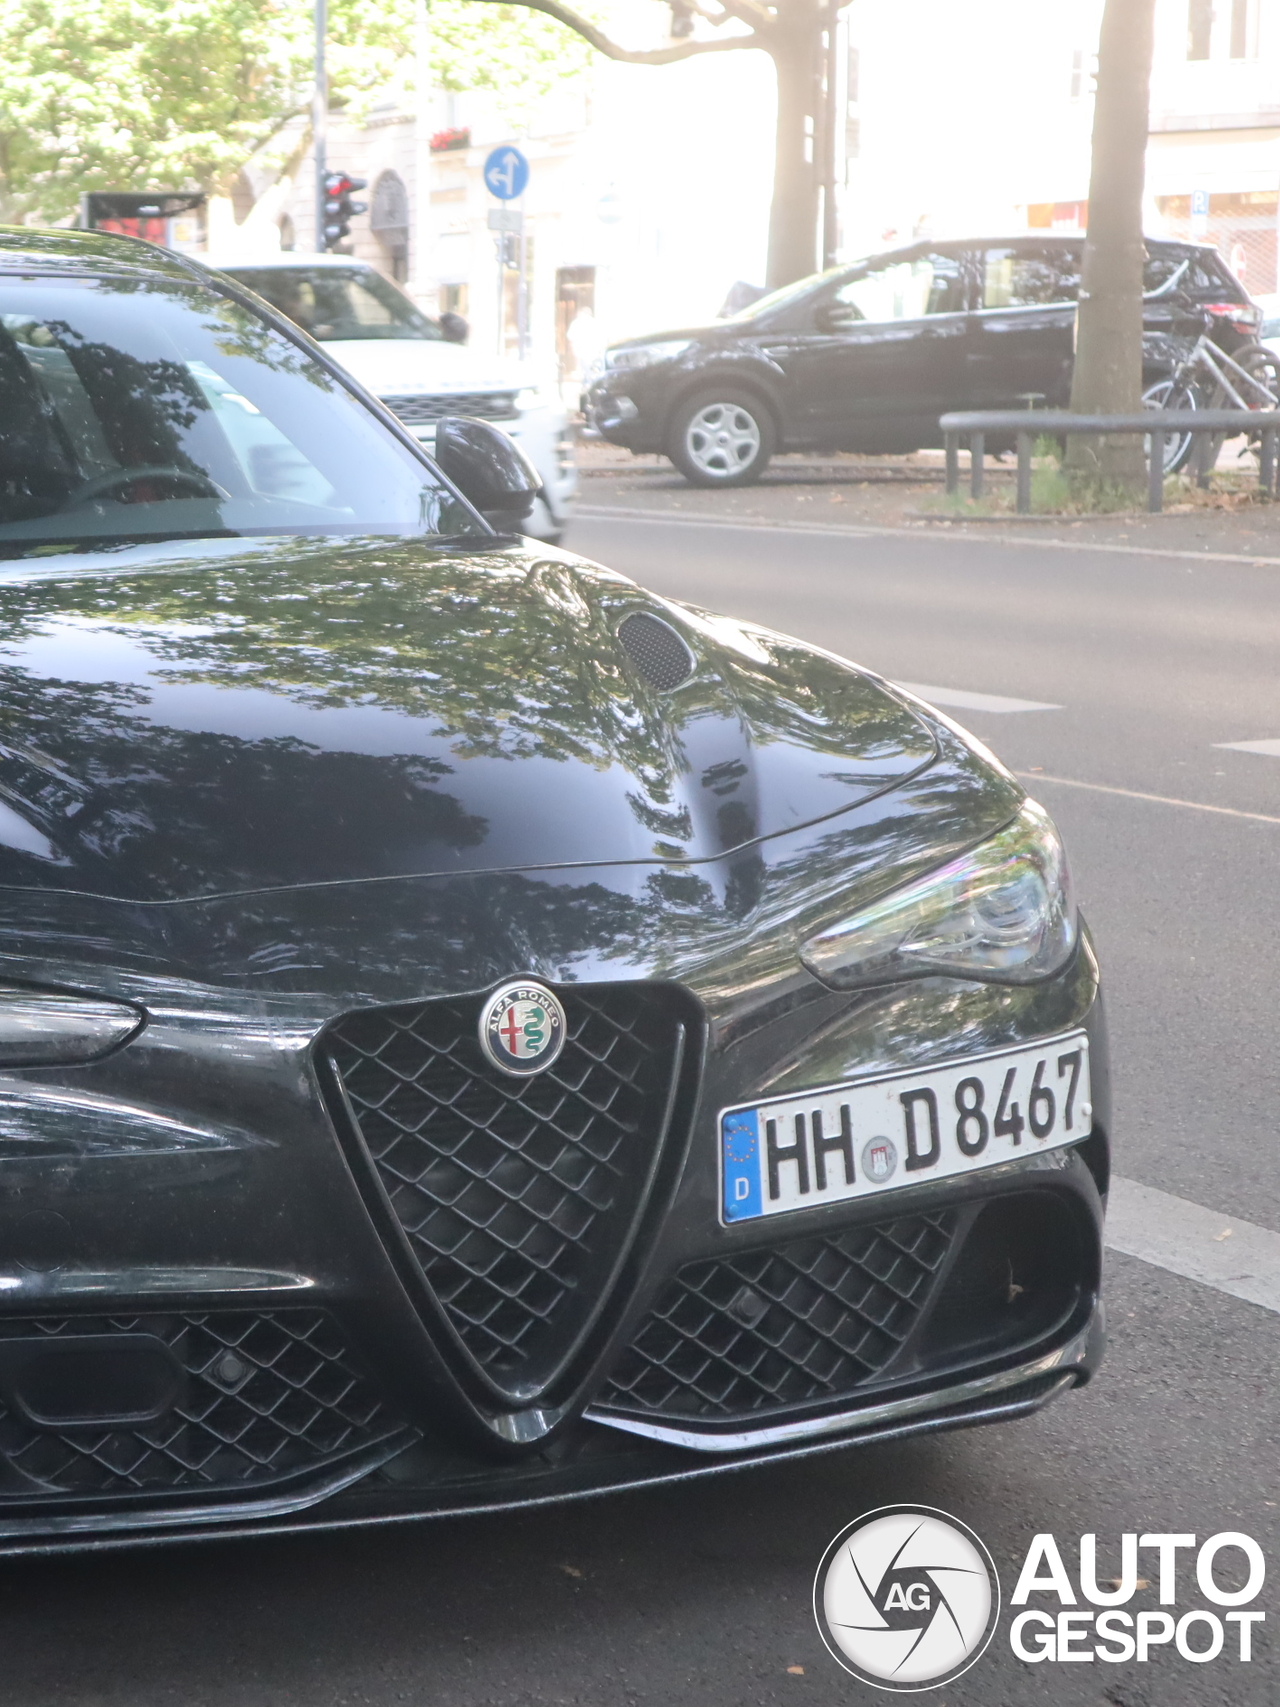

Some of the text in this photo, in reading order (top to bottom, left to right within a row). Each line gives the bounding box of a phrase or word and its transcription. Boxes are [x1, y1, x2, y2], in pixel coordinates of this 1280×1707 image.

[490, 991, 559, 1032] ALFA ROMEO
[766, 1050, 1082, 1201] HH D 8467
[734, 1177, 750, 1201] D
